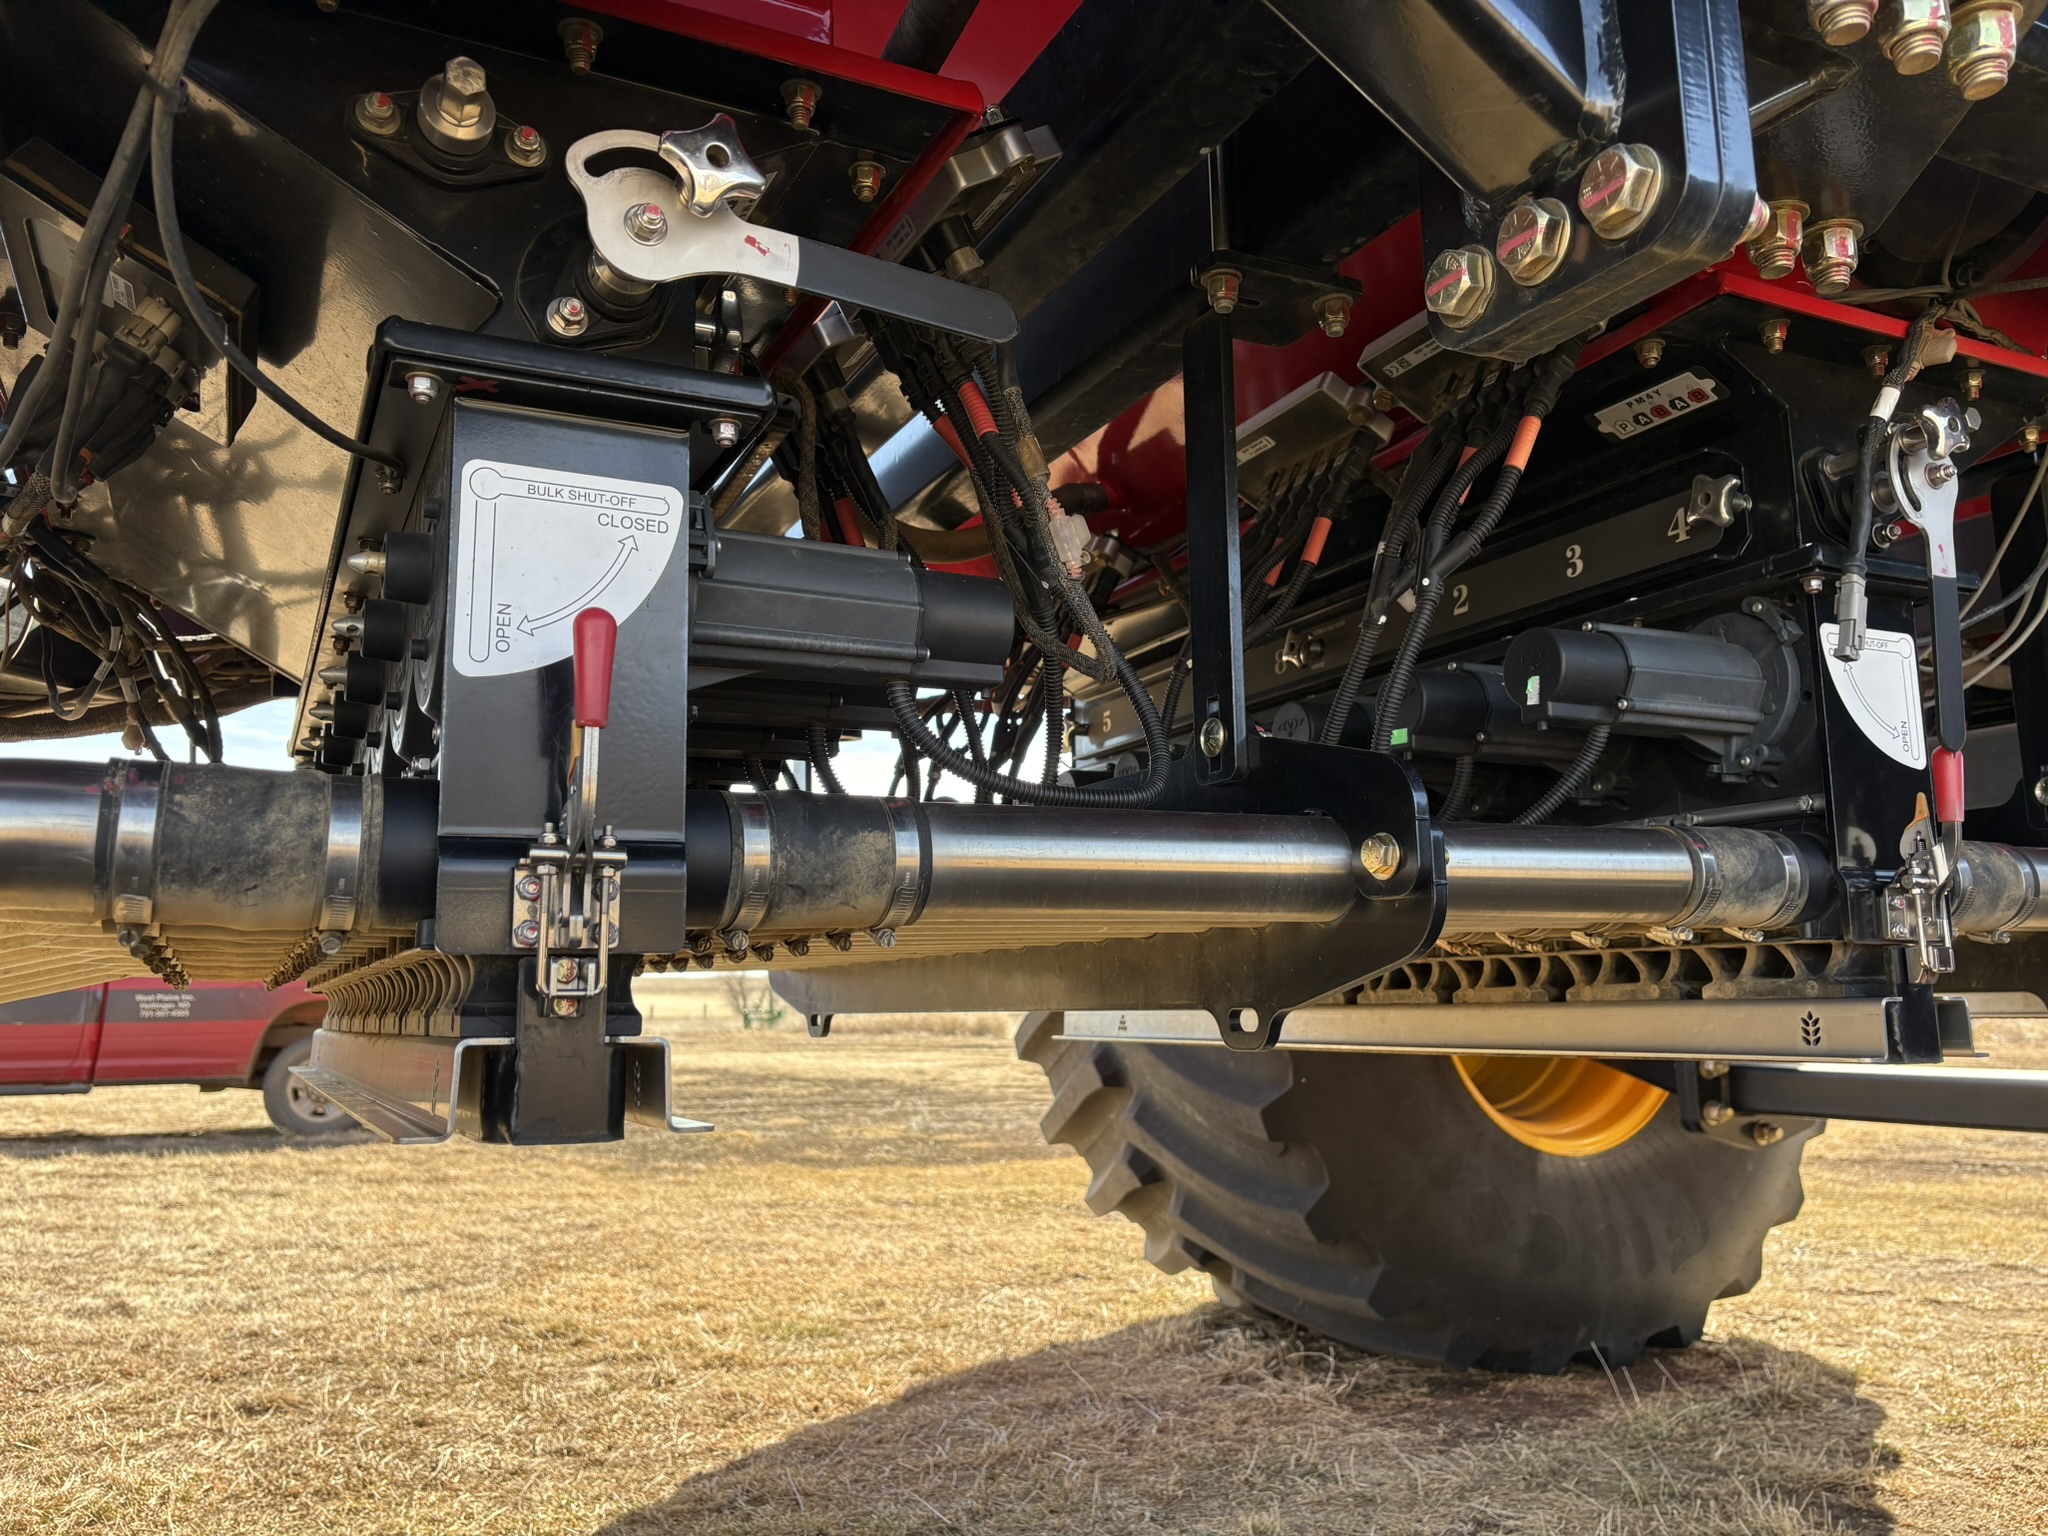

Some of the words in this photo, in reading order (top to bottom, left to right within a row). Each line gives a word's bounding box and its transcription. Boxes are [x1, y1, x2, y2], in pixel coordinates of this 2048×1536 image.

[527, 484, 564, 499] BULK
[568, 489, 637, 508] SHUT-OFF
[597, 513, 669, 534] CLOSED
[1667, 507, 1691, 543] 4
[1565, 544, 1584, 578] 3
[1453, 584, 1469, 616] 2
[495, 603, 512, 653] OPEN
[1865, 640, 1889, 649] HUT-OFF
[1102, 708, 1112, 733] 5
[1901, 720, 1910, 752] OPEN
